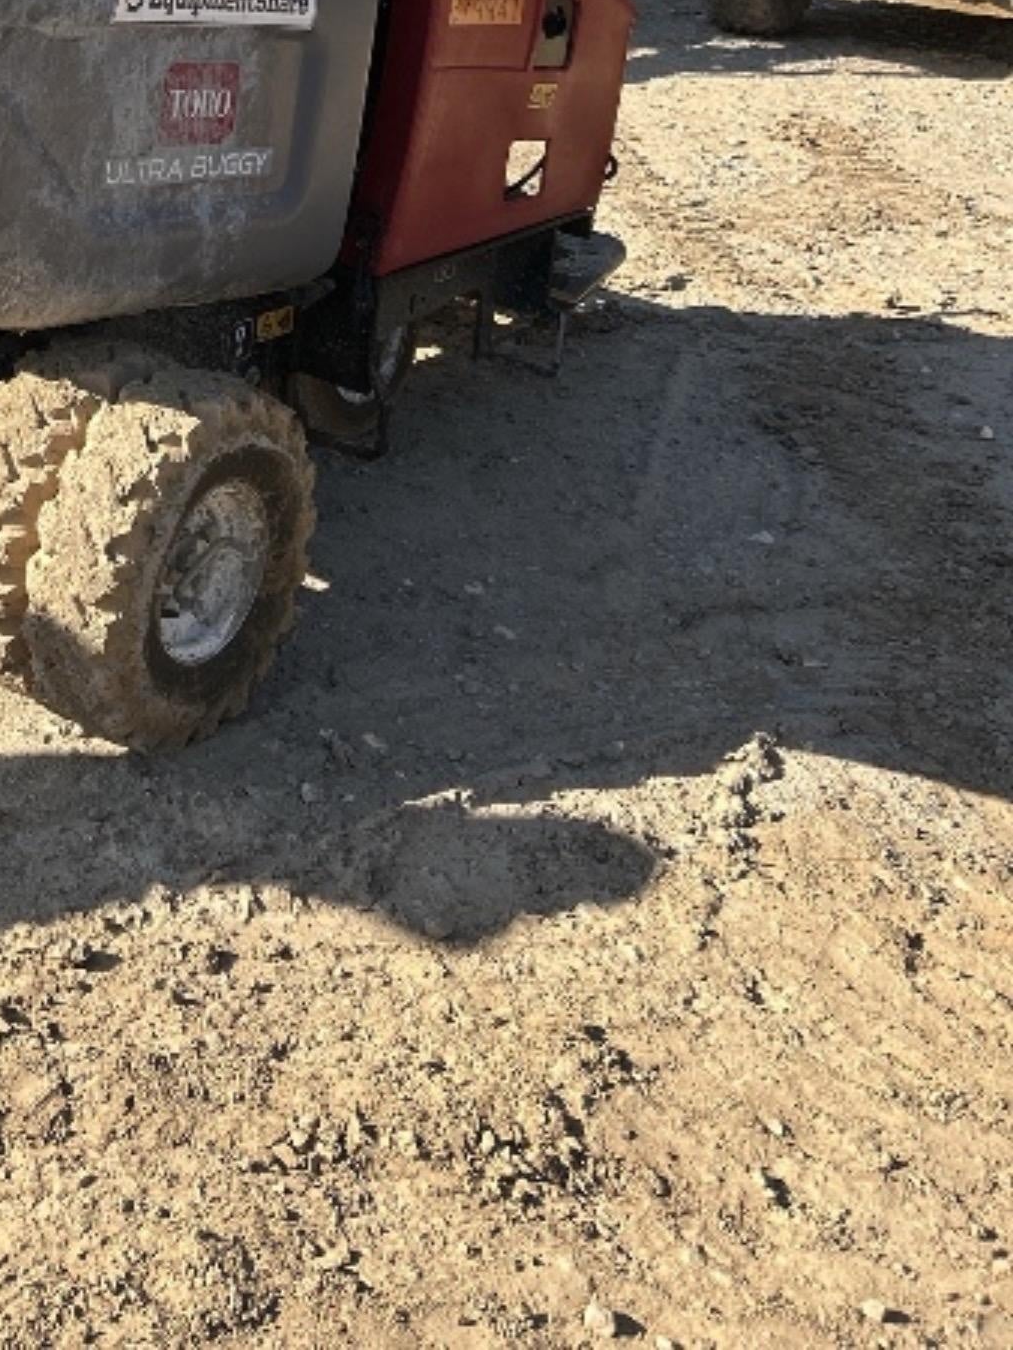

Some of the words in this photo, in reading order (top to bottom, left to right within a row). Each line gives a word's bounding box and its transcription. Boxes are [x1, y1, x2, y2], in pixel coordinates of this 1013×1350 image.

[170, 89, 232, 119] TORO
[106, 157, 183, 185] ULTRA
[190, 152, 268, 179] BUGGY
